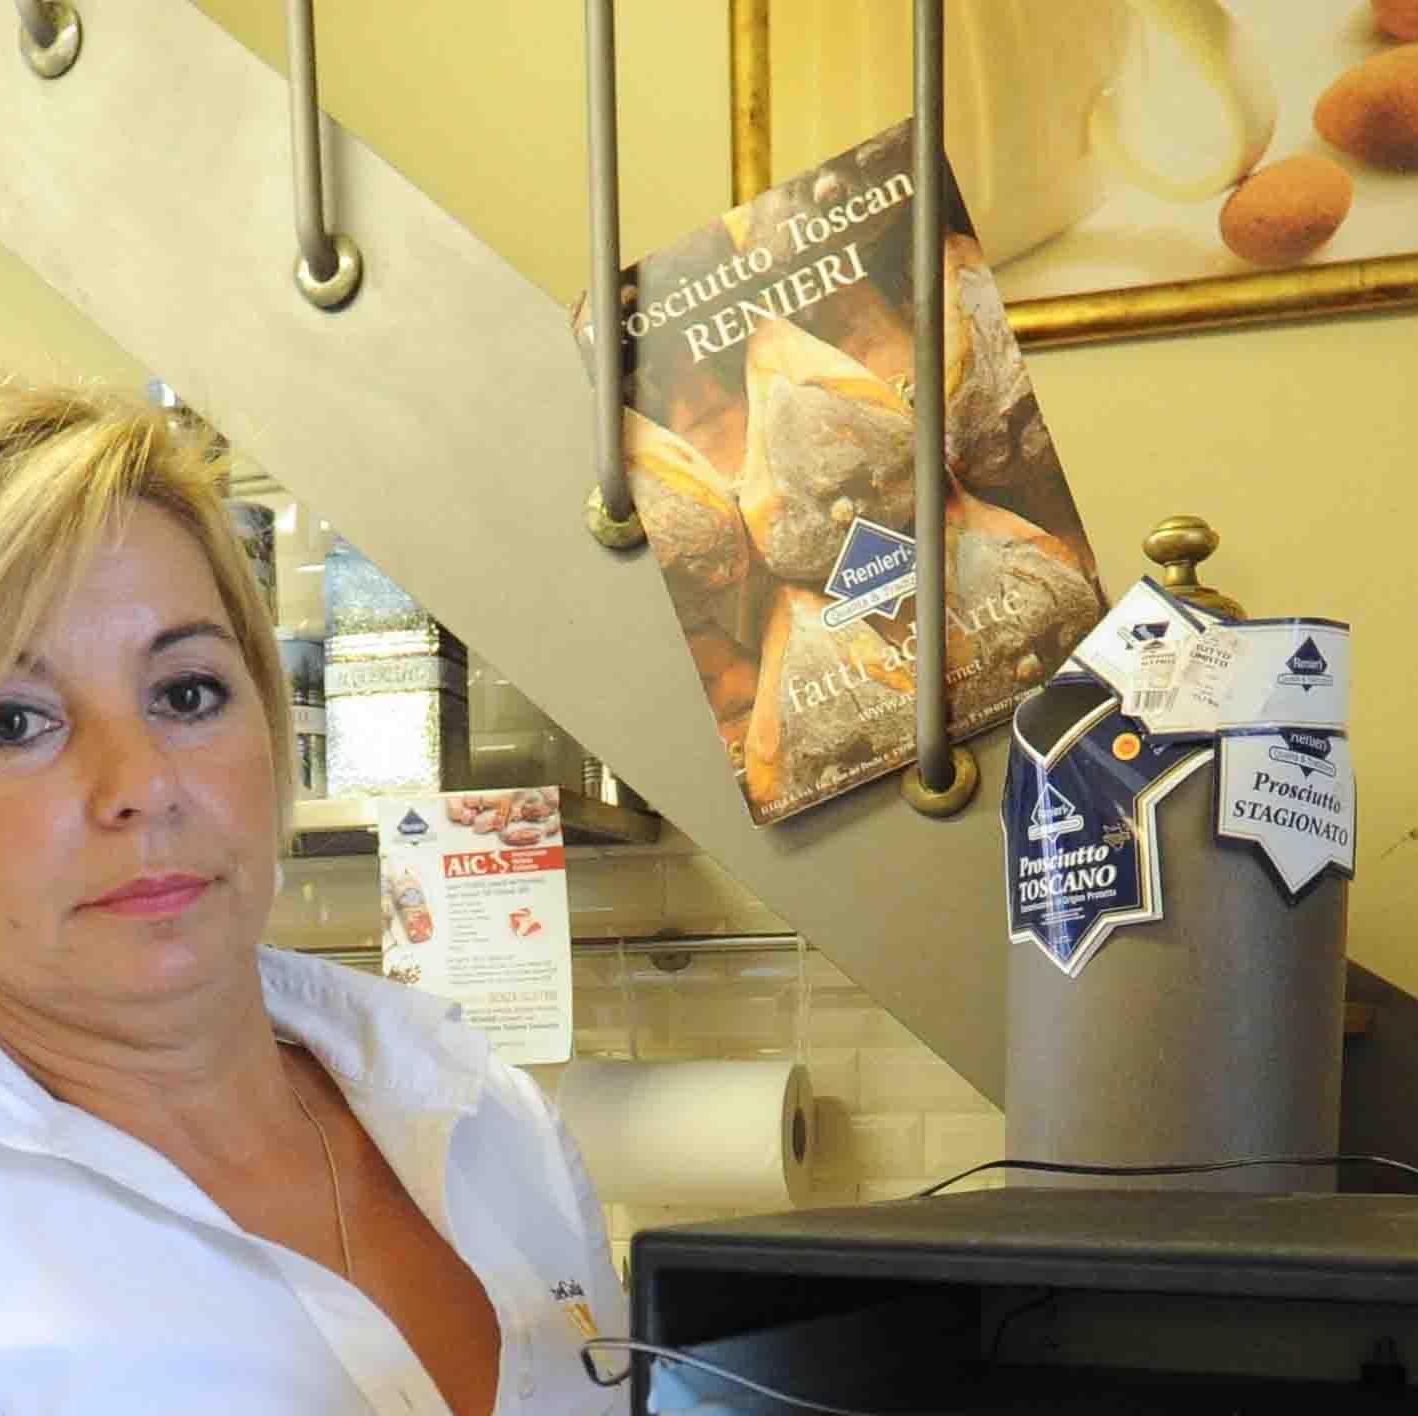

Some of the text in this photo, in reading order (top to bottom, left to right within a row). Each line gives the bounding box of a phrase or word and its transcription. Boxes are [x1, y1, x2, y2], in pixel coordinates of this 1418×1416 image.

[581, 172, 917, 345] osciutto Toscan
[683, 242, 870, 364] RENIERI
[788, 657, 871, 713] fatti
[1252, 770, 1342, 814] Prosciutto
[1232, 799, 1349, 847] STAGIONATO
[447, 854, 488, 877] AIC
[1018, 843, 1110, 879] Prosciutto
[1018, 864, 1118, 903] TOSCANO
